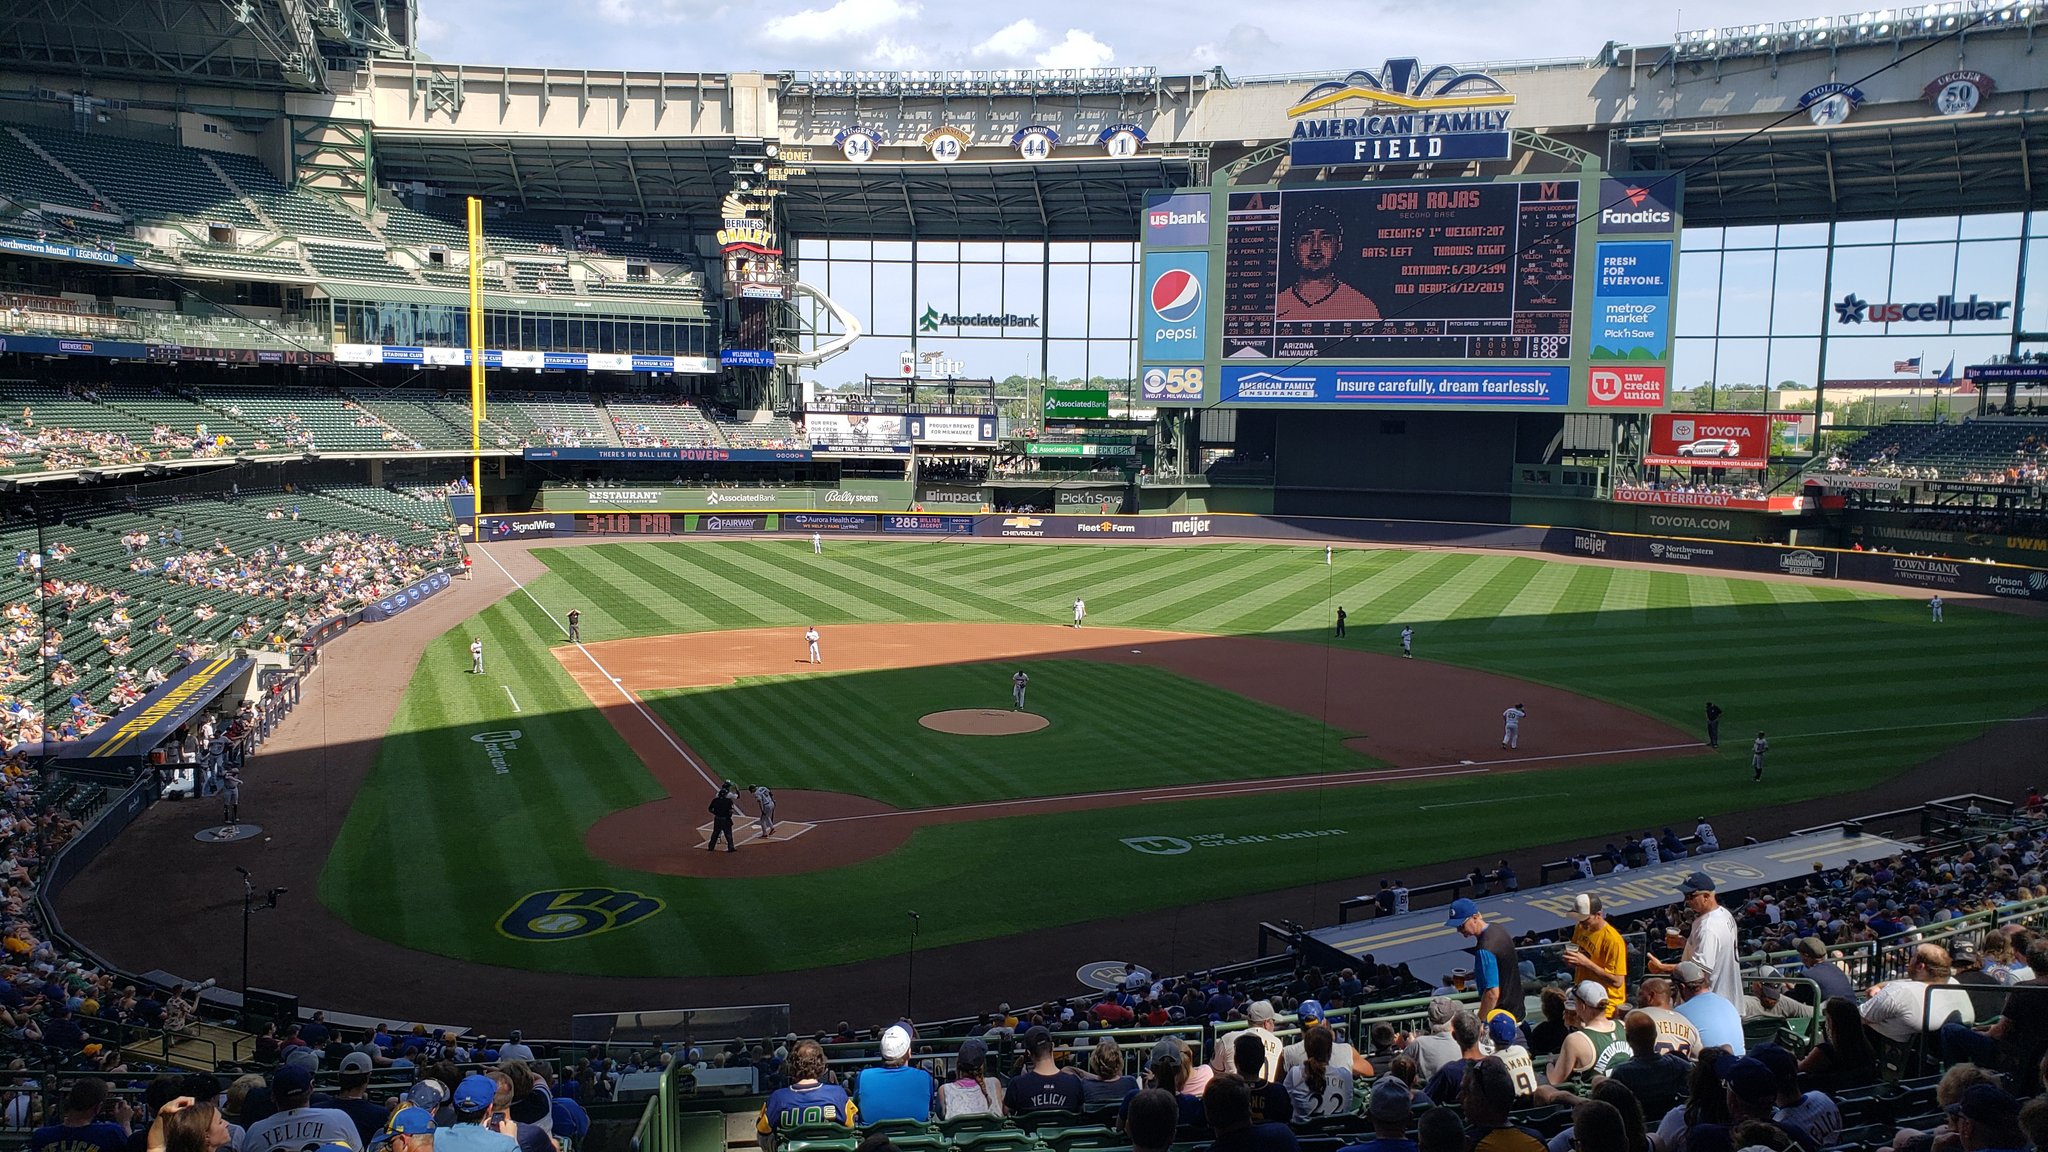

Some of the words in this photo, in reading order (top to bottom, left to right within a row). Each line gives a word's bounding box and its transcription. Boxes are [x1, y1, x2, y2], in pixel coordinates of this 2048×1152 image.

[1937, 71, 1981, 86] UECKER
[1946, 85, 1971, 101] 50
[1822, 101, 1837, 118] 4
[842, 126, 875, 137] FINGERS
[1023, 127, 1049, 136] AARON
[1292, 115, 1414, 139] AMERICAN
[1423, 110, 1512, 132] FAMILY
[848, 140, 869, 156] 34
[935, 140, 957, 156] 42
[1024, 139, 1046, 156] 44
[1118, 138, 1128, 155] 1
[1354, 137, 1443, 160] FIELD
[779, 151, 813, 161] GONE!
[783, 168, 806, 176] OUTTA
[768, 189, 778, 197] UP
[1540, 181, 1560, 202] M
[745, 203, 759, 211] GET
[760, 203, 770, 211] UP
[1377, 192, 1418, 211] JOSH
[1427, 190, 1480, 209] ROJAS
[1150, 211, 1207, 226] usbank
[1400, 211, 1431, 219] SECOND
[1602, 209, 1670, 224] Fanatics
[726, 219, 764, 229] BERNIE'S
[716, 228, 772, 246] CHALET
[45, 244, 70, 256] Mutual
[76, 249, 103, 261] LEGENDS
[103, 251, 119, 263] CLUB
[1362, 247, 1388, 258] BATS:
[1390, 247, 1413, 257] LEFT
[1433, 245, 1474, 256] THROWS:
[1476, 244, 1506, 255] RIGHT
[1604, 257, 1637, 266] FRESH
[1603, 267, 1625, 275] FOR
[1602, 276, 1664, 285] EVERYONE.
[1394, 284, 1415, 294] MLB
[1606, 303, 1643, 313] metro
[1868, 294, 2012, 322] uscellular
[1605, 314, 1649, 323] market
[1155, 326, 1197, 342] pepsi
[1631, 330, 1655, 338] Save
[1165, 369, 1203, 394] 58
[1624, 374, 1644, 382] uw
[1239, 381, 1281, 390] AMERICAN
[1284, 381, 1315, 390] FAMILY
[1336, 378, 1376, 393] Insure
[1378, 378, 1436, 394] carefully,
[1438, 378, 1479, 393] dream
[1481, 379, 1549, 396] fearlessly.
[1624, 381, 1660, 390] credit
[1624, 390, 1660, 400] union
[1699, 426, 1752, 437] TOYOTA
[599, 451, 626, 459] THERE'S
[627, 451, 637, 459] NO
[638, 451, 656, 459] BALL
[656, 451, 671, 459] LIKE
[672, 451, 678, 459] A
[680, 450, 721, 461] POWER
[1823, 475, 1899, 491] ShoreWEST.COM
[1946, 484, 1964, 492] GREAT
[1987, 486, 2002, 494] LESS
[588, 491, 658, 500] RESTAURANT
[825, 491, 857, 505] Bally
[855, 495, 879, 503] SPORTS
[937, 489, 982, 503] impact
[1095, 493, 1124, 504] Save
[1616, 490, 1661, 502] TOYOTA
[1663, 492, 1731, 506] TERRITORY
[512, 520, 556, 533] SignalWire
[641, 514, 671, 533] PM
[721, 519, 756, 527] FAIRWAY
[851, 516, 865, 524] Care
[1171, 516, 1211, 535] meijer
[1650, 515, 1731, 531] TOYOTA.COM
[1077, 523, 1101, 532] Fleet
[1111, 524, 1136, 533] Farm
[1574, 533, 1607, 554] meijer
[1665, 545, 1714, 556] Northwestern
[1665, 552, 1691, 560] Mutual
[1782, 554, 1824, 570] Johnsonville
[1893, 558, 1928, 571] TOWN
[1928, 562, 1960, 576] BANK
[1900, 572, 1936, 582] WINTRUST
[1937, 576, 1956, 584] BANK
[1988, 575, 2023, 587] Johnson
[1995, 585, 2030, 597] Controls
[1657, 1022, 1691, 1039] YELICH
[1515, 1071, 1532, 1095] 9
[1030, 1092, 1067, 1107] YELICH
[1308, 1093, 1345, 1118] 22
[262, 1121, 325, 1146] YELICH
